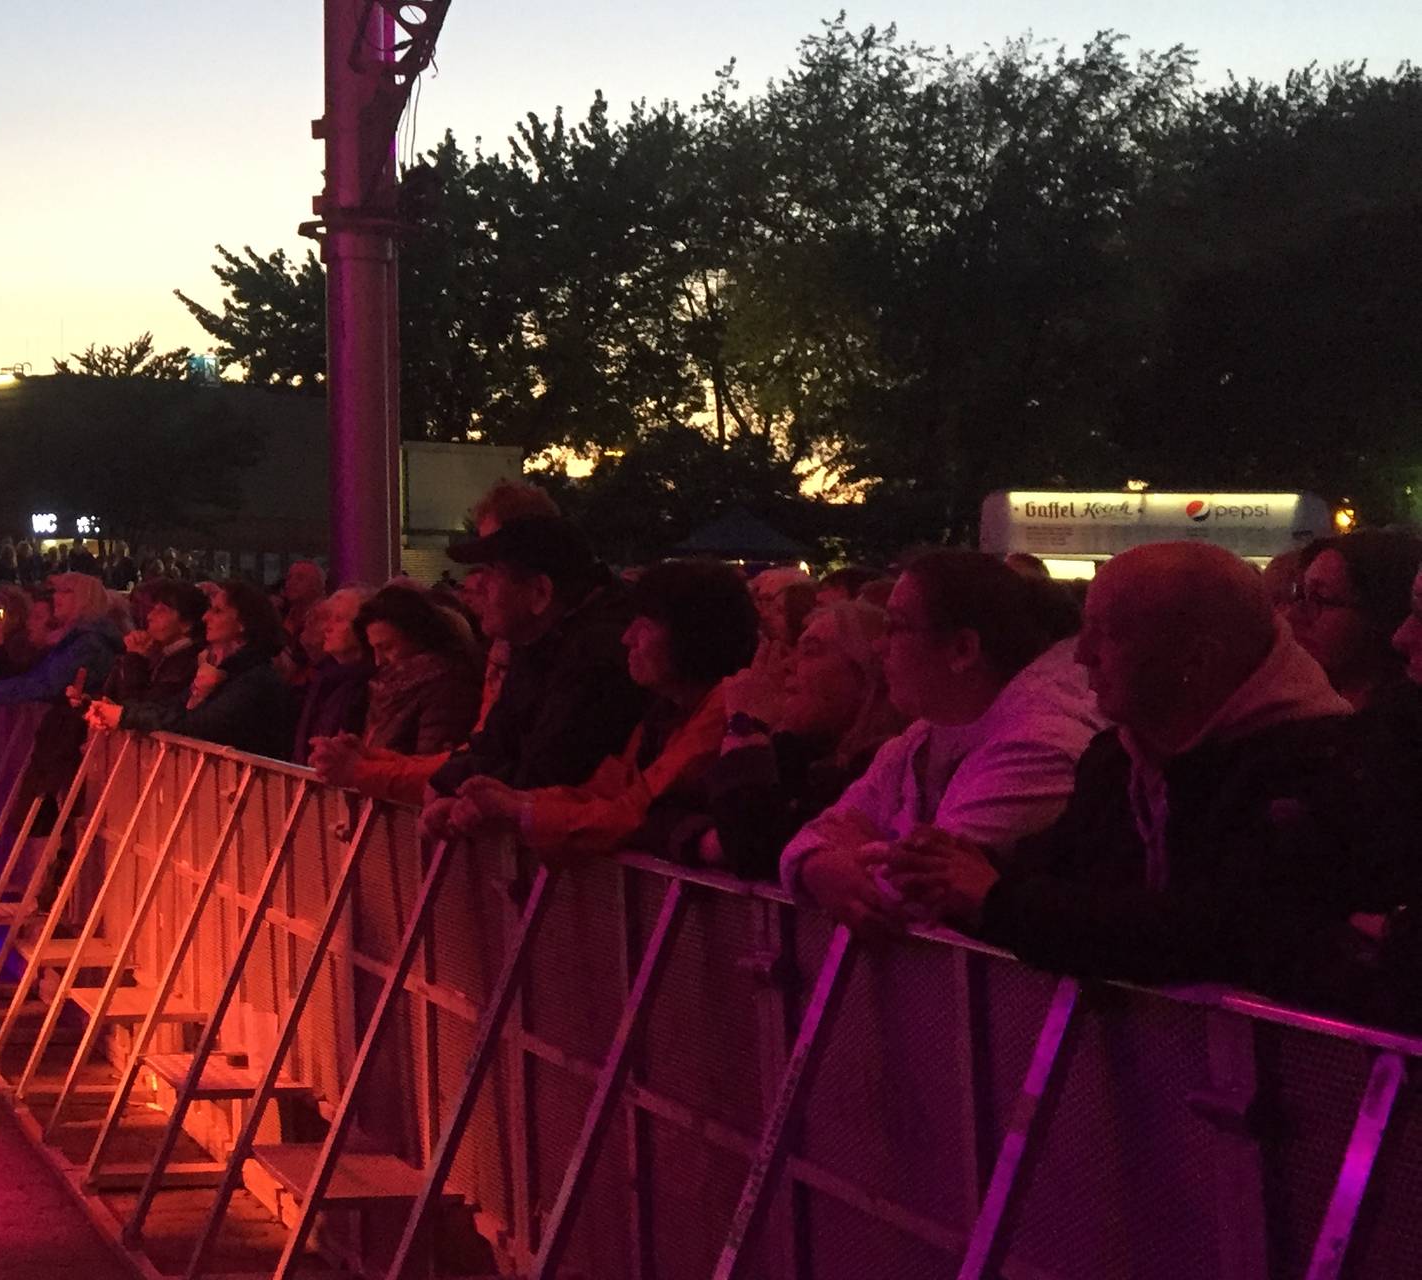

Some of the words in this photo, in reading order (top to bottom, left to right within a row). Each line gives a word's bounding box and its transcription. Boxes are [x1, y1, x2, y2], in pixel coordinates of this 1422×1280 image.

[1024, 501, 1076, 518] Gaffel
[1215, 504, 1269, 520] pepsi
[32, 513, 57, 533] WC
